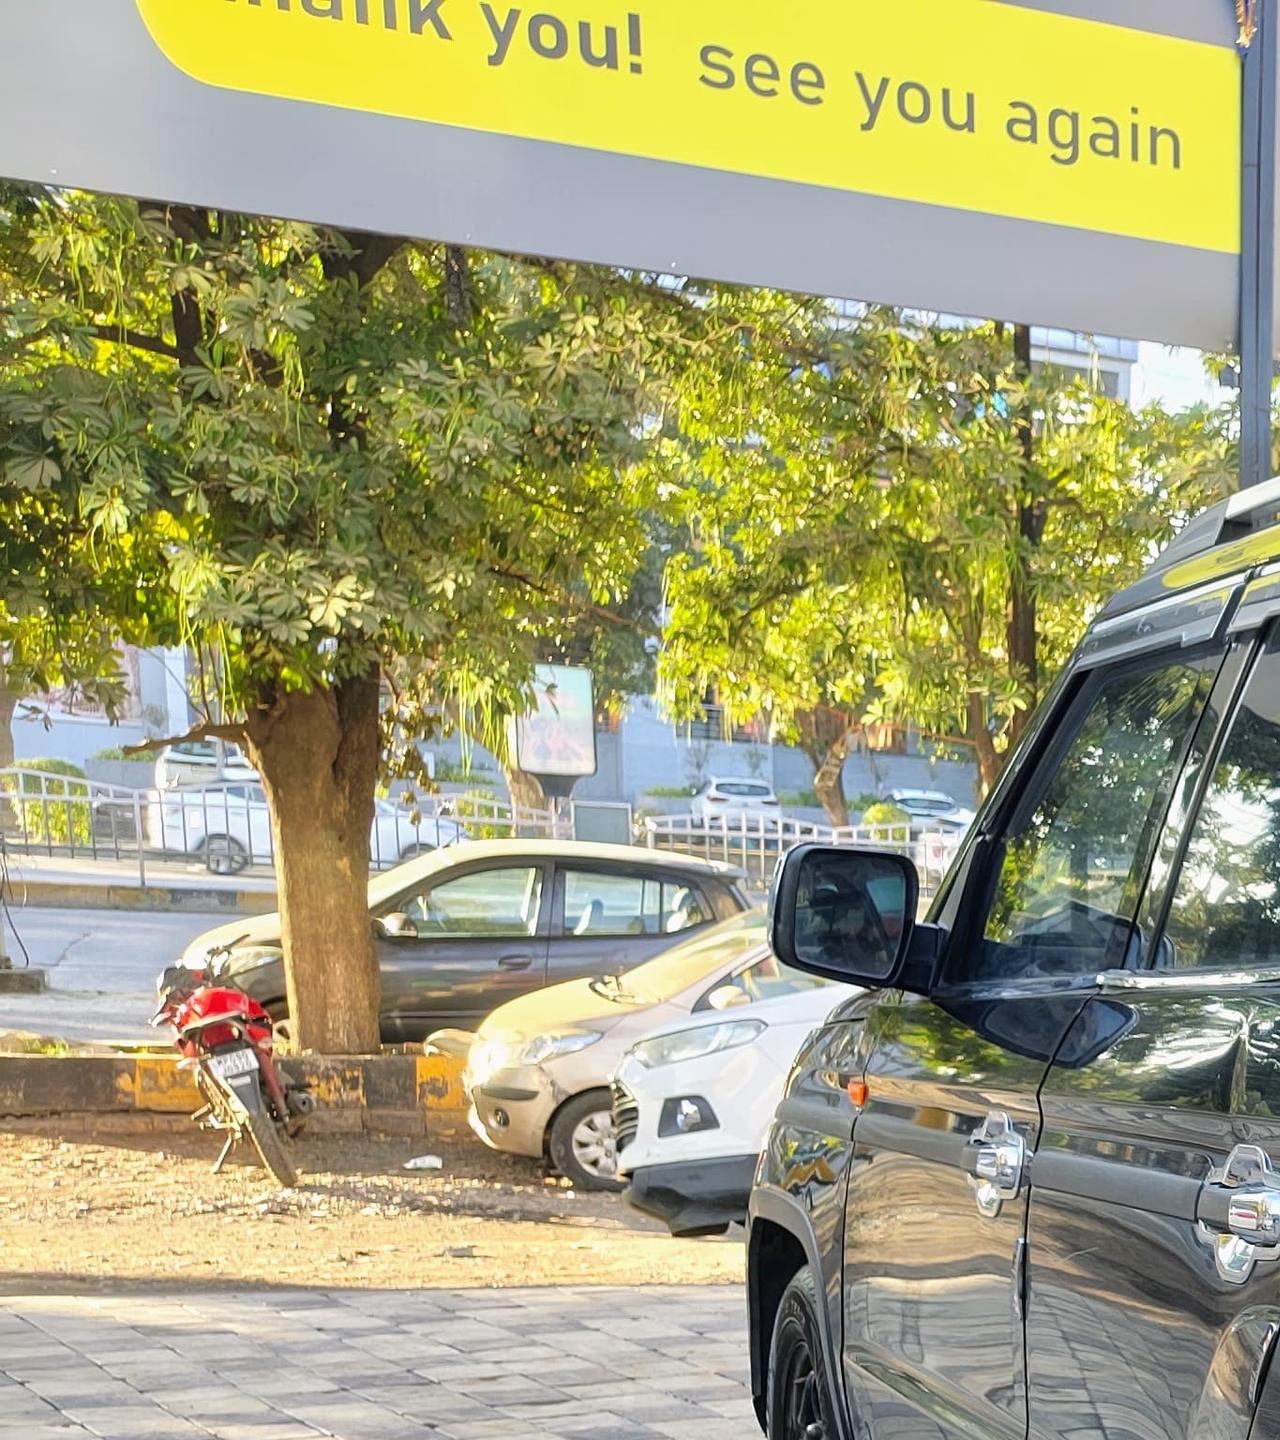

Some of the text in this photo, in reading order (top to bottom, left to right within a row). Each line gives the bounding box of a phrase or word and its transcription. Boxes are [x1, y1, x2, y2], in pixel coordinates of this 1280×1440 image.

[479, 1, 643, 75] you!
[698, 43, 826, 105] see
[853, 71, 976, 133] you
[1005, 101, 1182, 170] again
